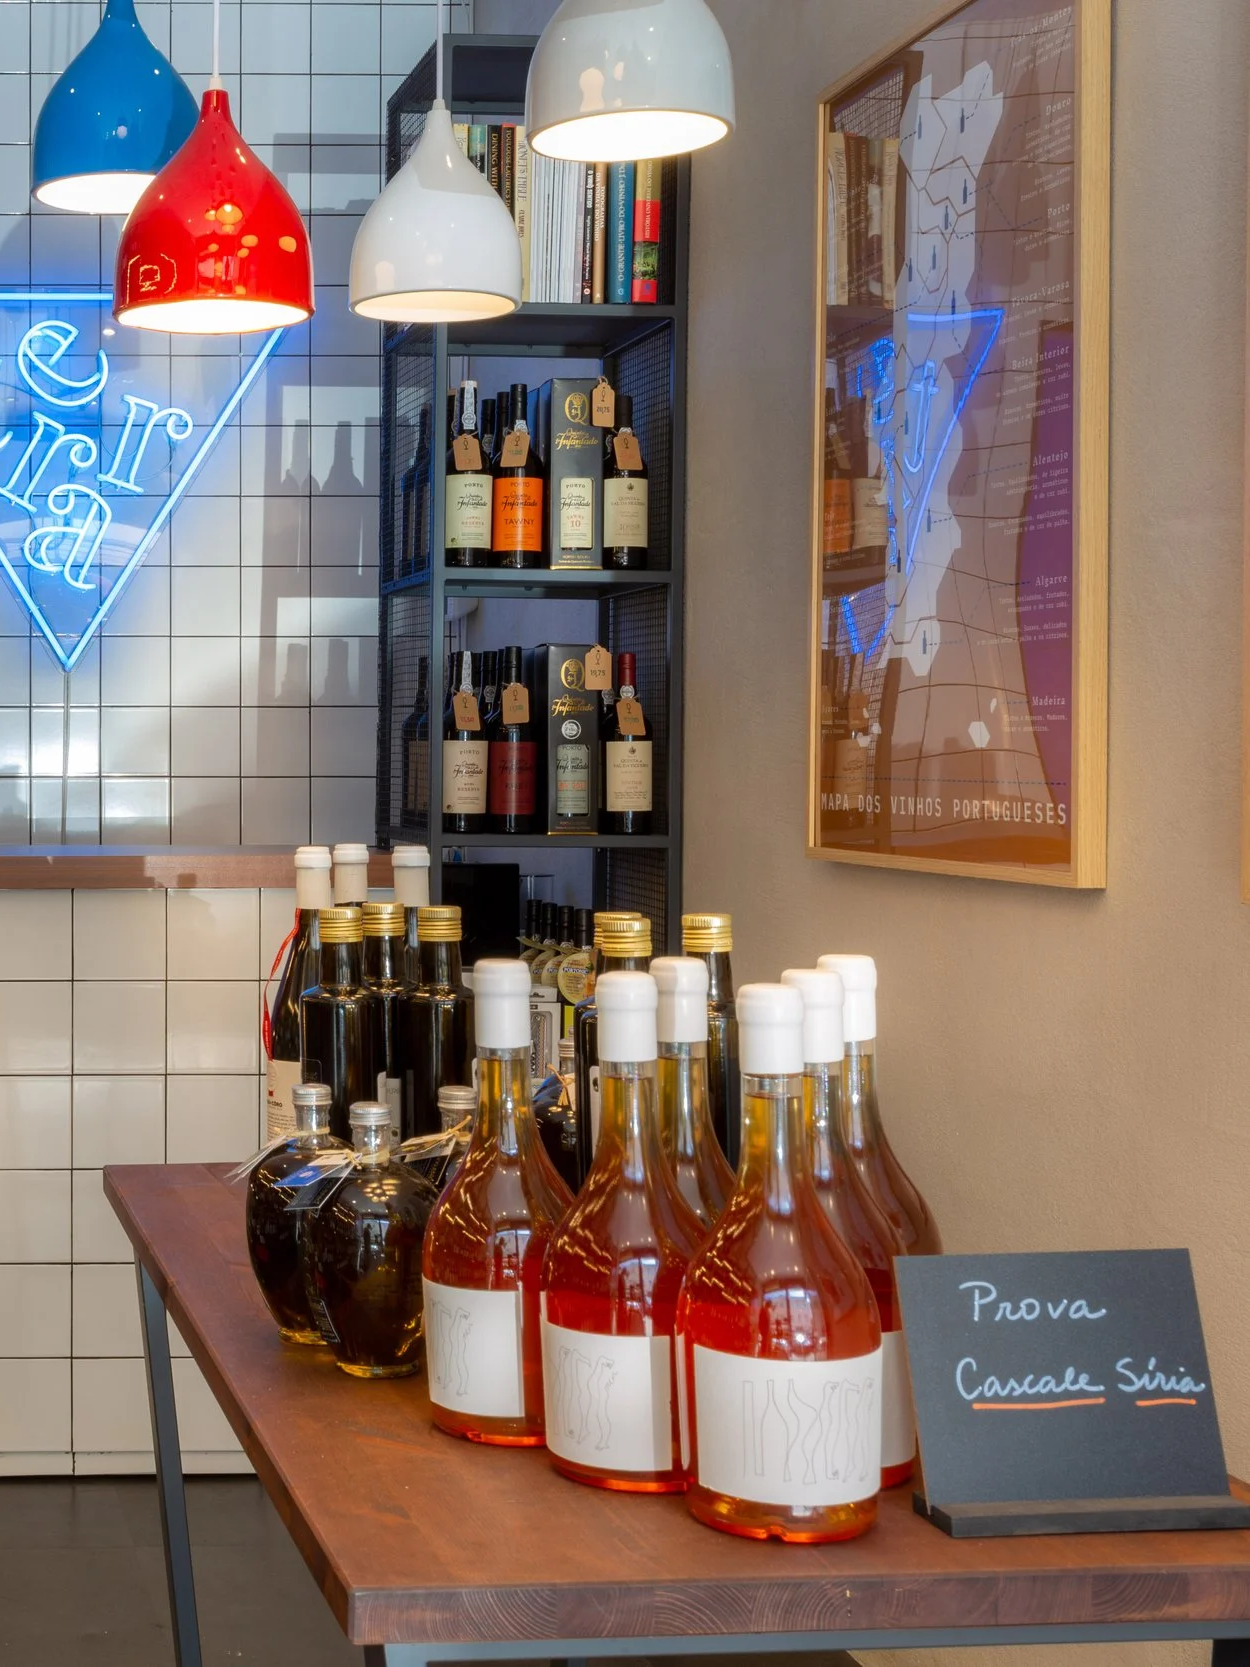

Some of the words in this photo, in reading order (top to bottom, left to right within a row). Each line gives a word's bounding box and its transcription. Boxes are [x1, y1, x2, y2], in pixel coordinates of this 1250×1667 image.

[1046, 97, 1071, 116] Douro
[491, 133, 499, 165] DINING
[1047, 203, 1070, 219] Porto
[1012, 356, 1033, 370] Beira
[1036, 346, 1070, 363] Interior
[1033, 450, 1069, 467] Alentejo
[570, 520, 581, 528] 10
[1035, 575, 1068, 588] Algarve
[1032, 694, 1066, 706] Madeira
[821, 792, 850, 811] MAPA
[858, 794, 881, 813] DOS
[890, 795, 942, 817] VINHOS
[953, 799, 1067, 825] PORTUGUESES
[959, 1281, 1107, 1322] Prova
[956, 1357, 1106, 1401] Cascale
[1115, 1357, 1206, 1393] Síria
